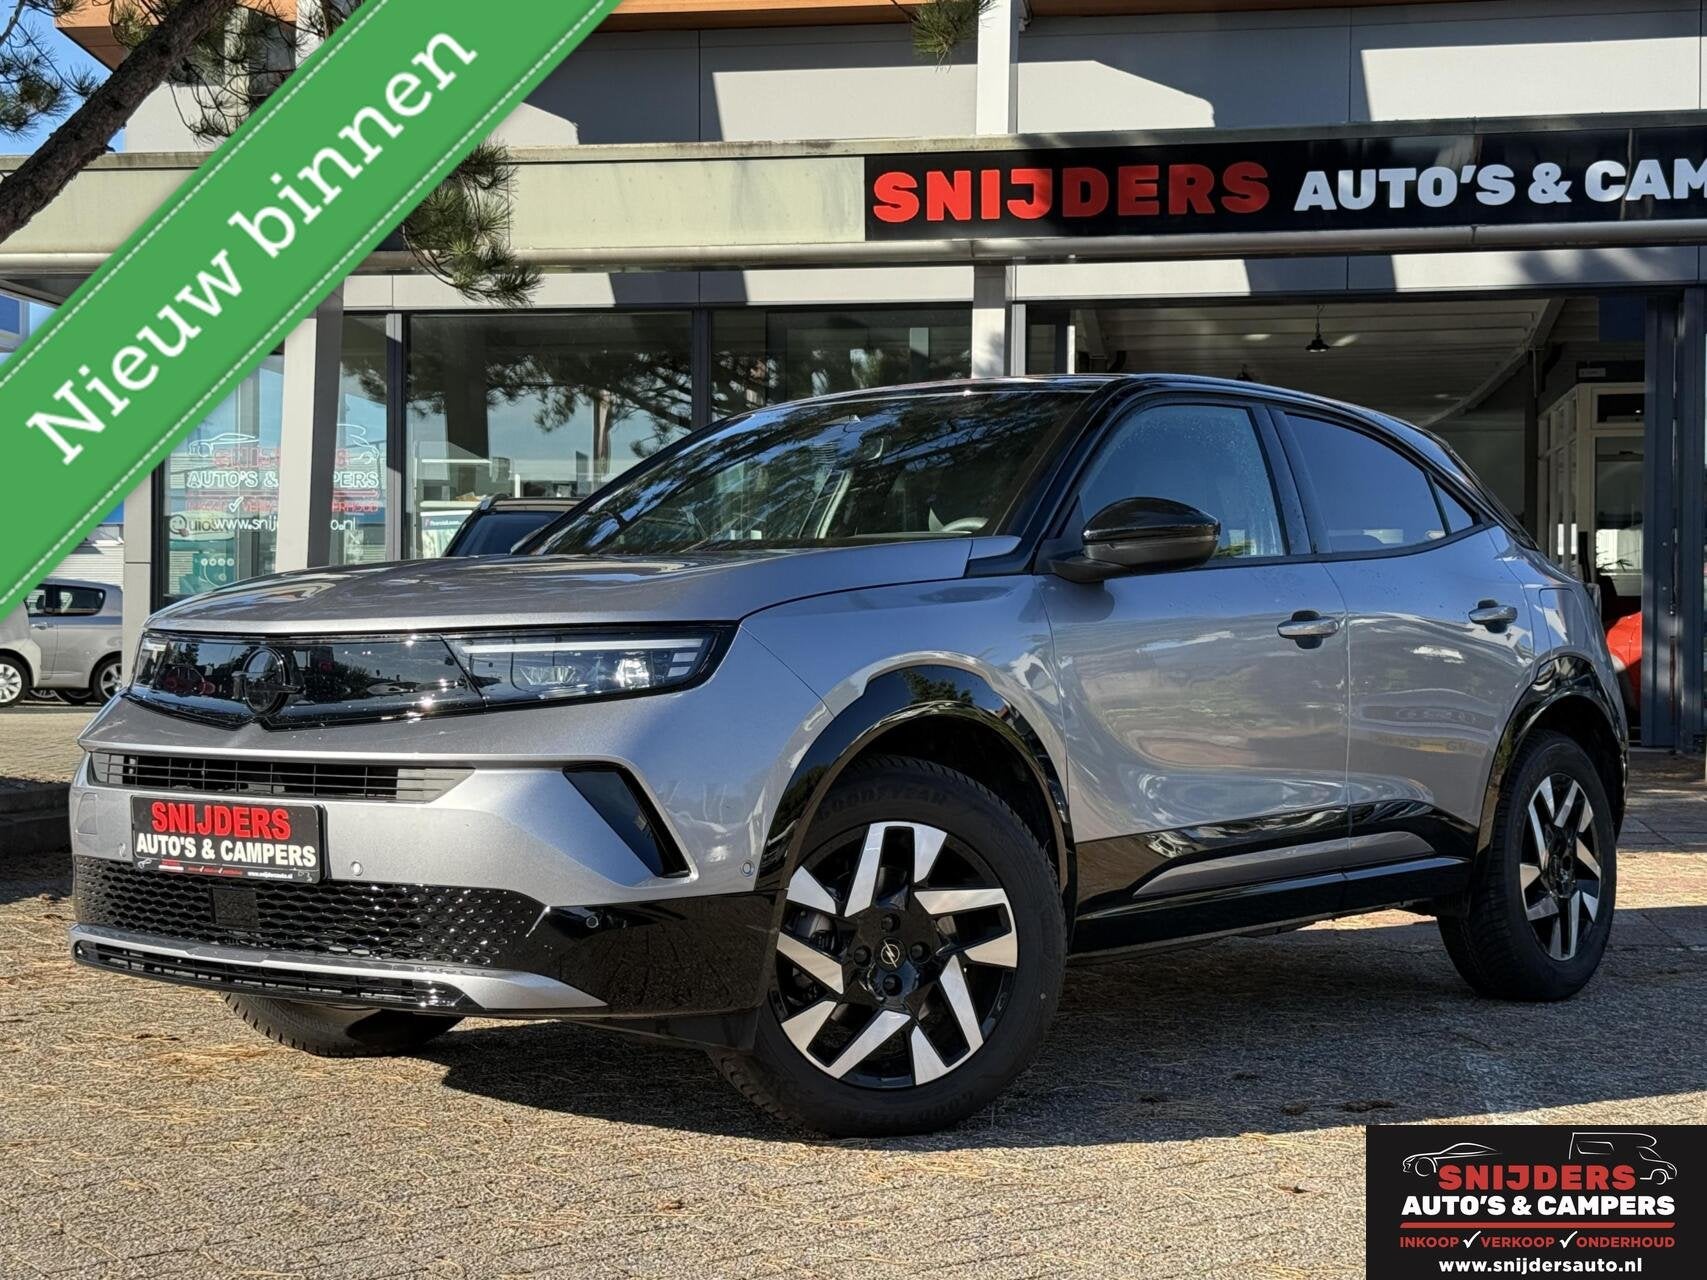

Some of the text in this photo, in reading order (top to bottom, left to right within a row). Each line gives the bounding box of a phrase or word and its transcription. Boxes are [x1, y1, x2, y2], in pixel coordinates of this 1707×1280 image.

[872, 161, 1270, 223] SNIJDERS
[1294, 164, 1515, 211] AUTO'S
[1527, 162, 1572, 204] &
[187, 471, 258, 487] AUTO'S
[263, 471, 279, 487] &
[151, 801, 292, 841] SNIJDERS
[136, 832, 317, 867] AUTO'S & CAMPERS
